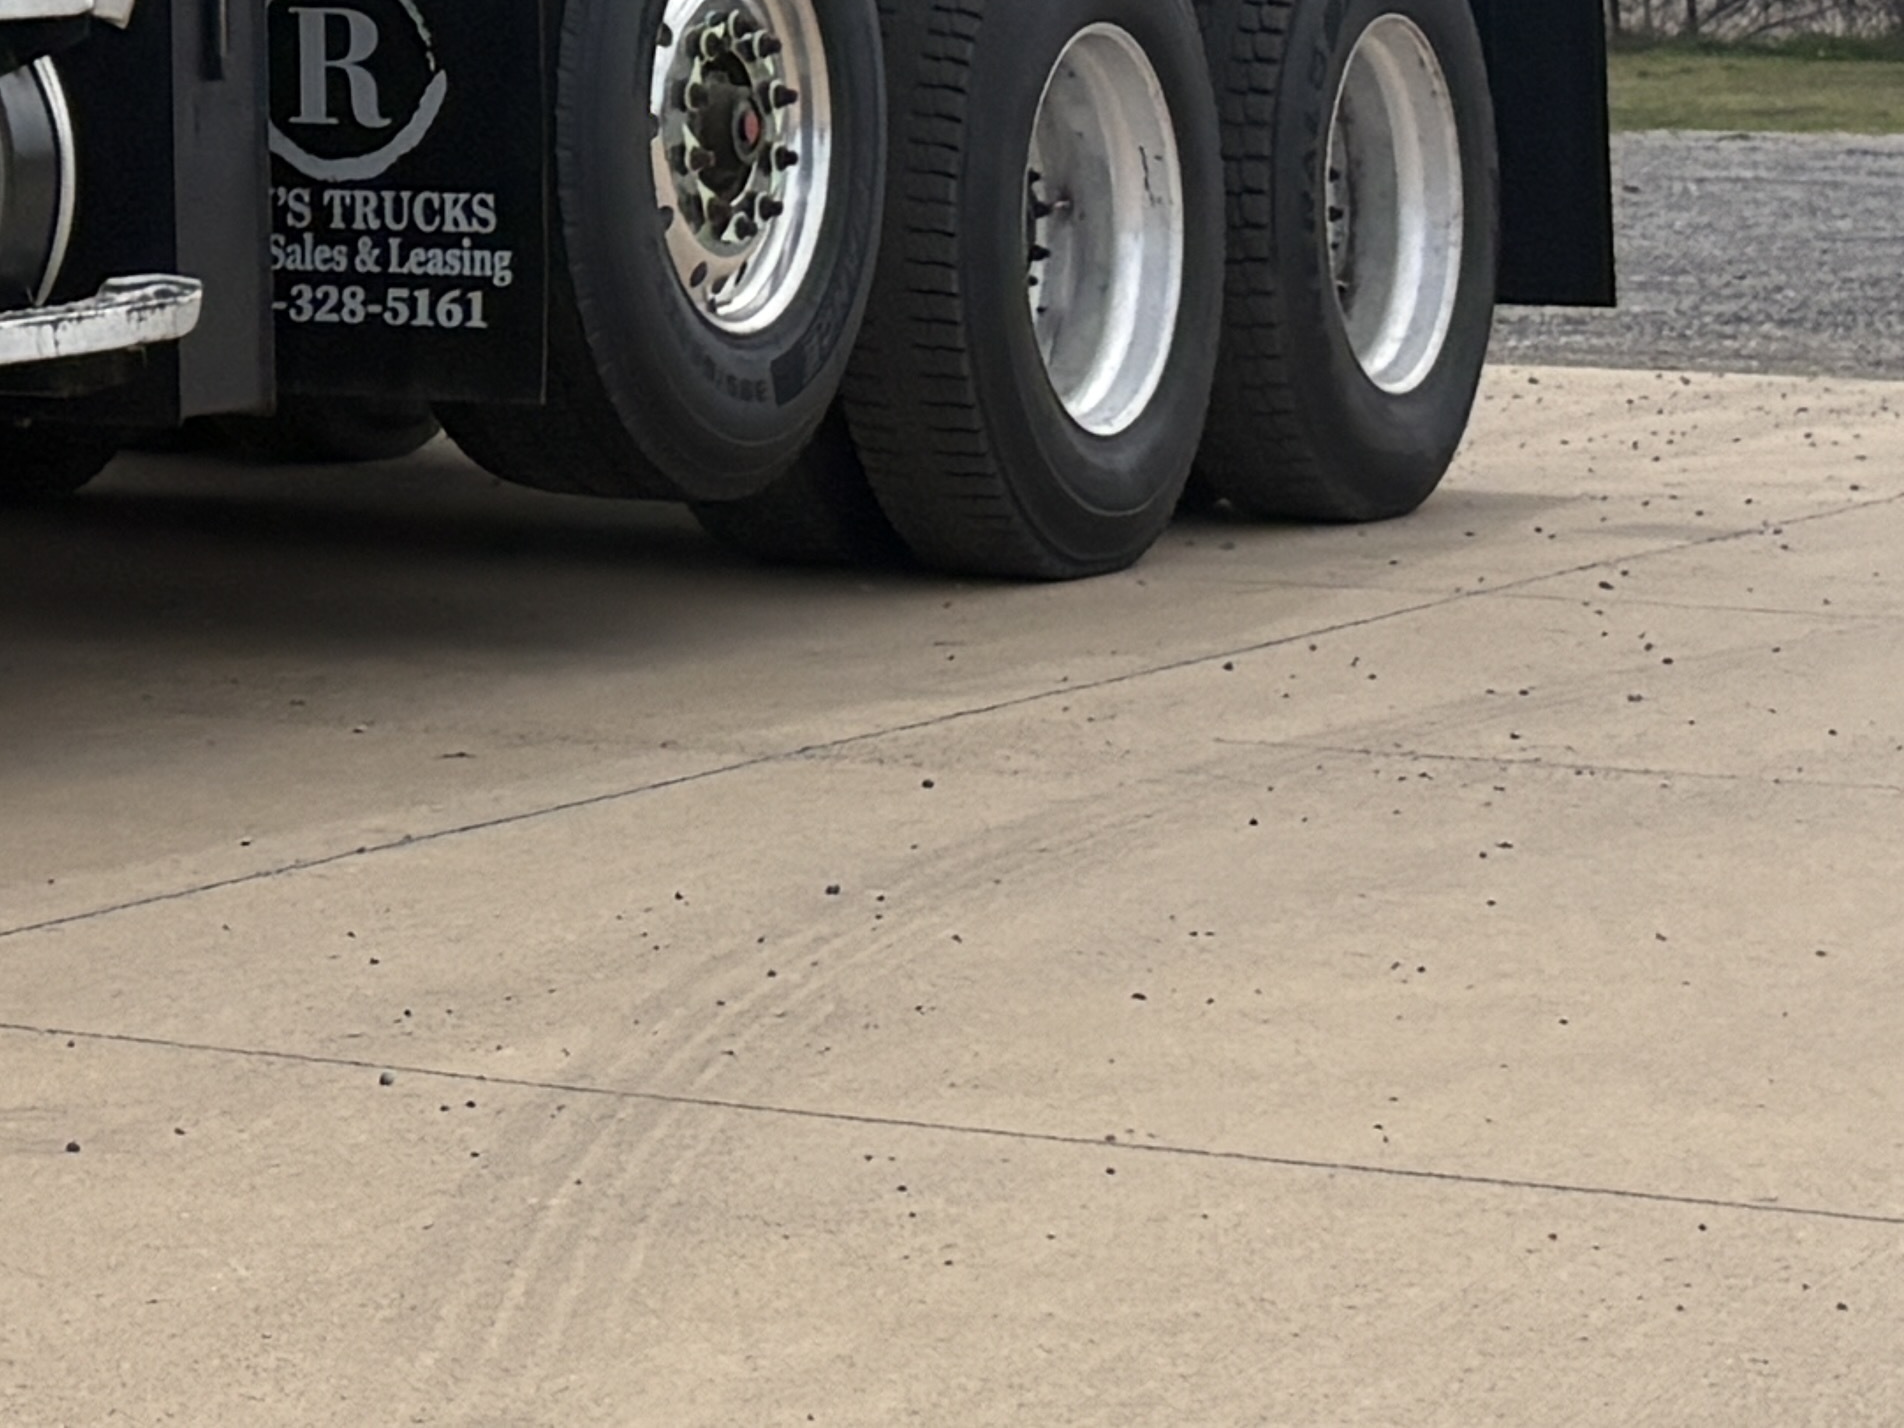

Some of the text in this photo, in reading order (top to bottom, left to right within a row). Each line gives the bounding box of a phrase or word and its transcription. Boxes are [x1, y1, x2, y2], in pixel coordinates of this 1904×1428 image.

[288, 6, 392, 129] R
[323, 189, 497, 234] TRUCKS
[270, 232, 513, 287] Sales & Leasing
